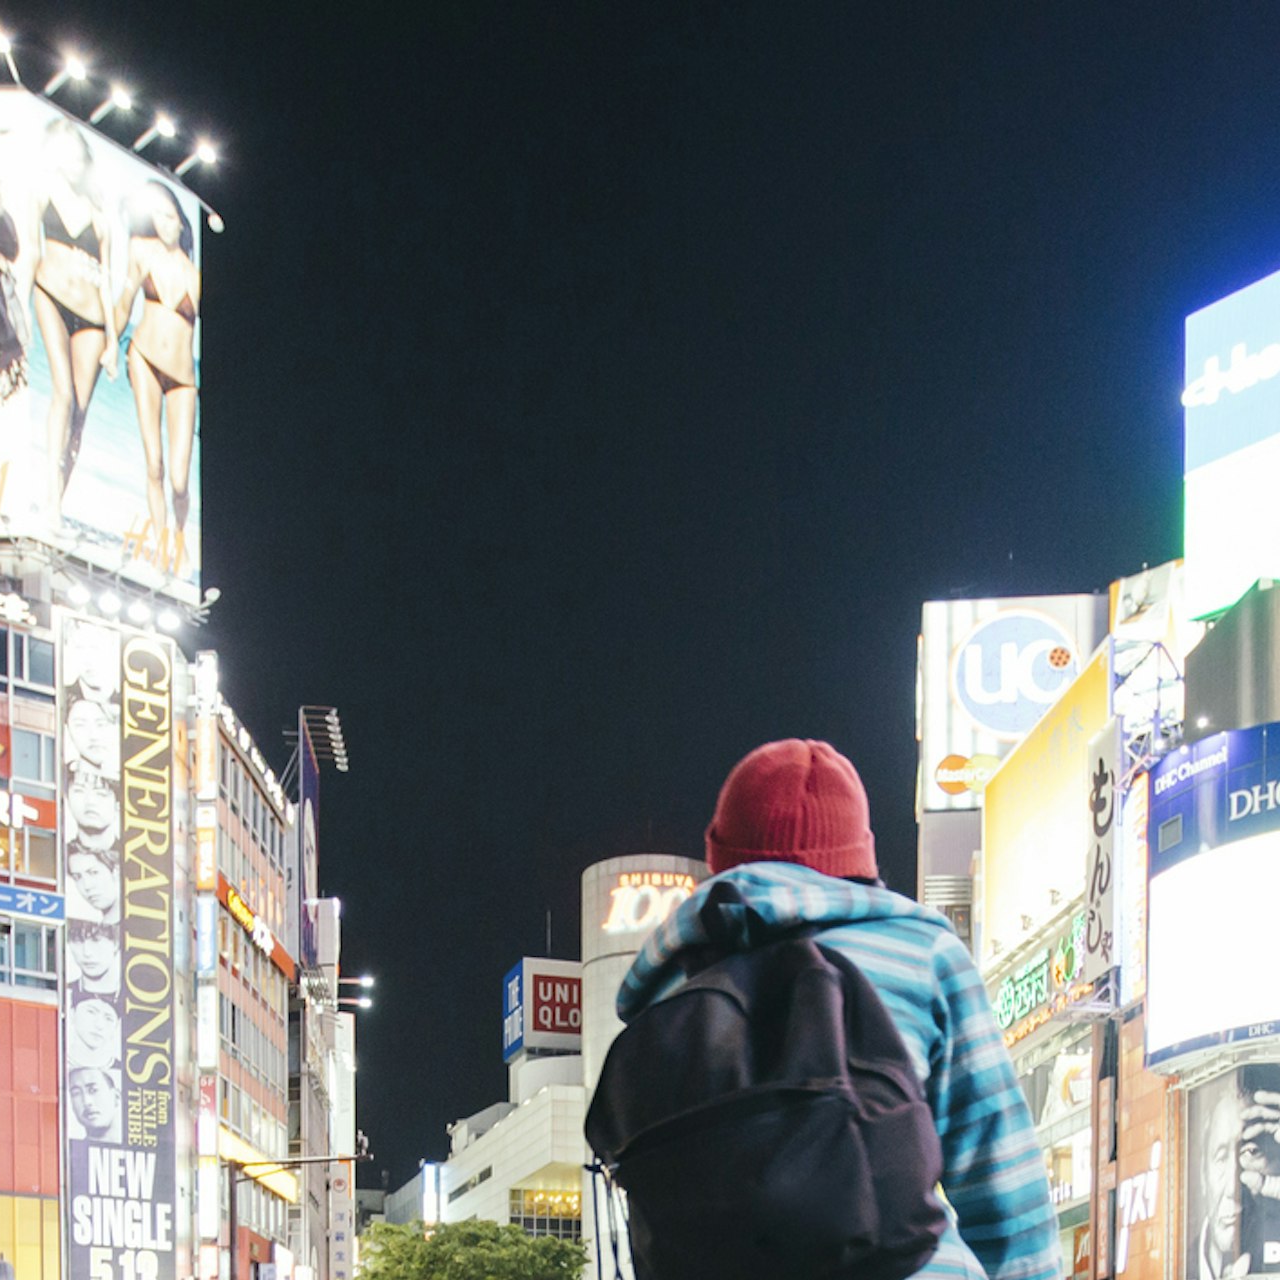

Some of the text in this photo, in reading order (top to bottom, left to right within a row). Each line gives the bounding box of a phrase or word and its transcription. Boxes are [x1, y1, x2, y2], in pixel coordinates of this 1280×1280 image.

[1154, 747, 1228, 795] DHC Channel
[123, 636, 171, 1085] GENERATIONS
[619, 872, 695, 889] SHIBUYA
[538, 981, 579, 1004] UNI
[538, 1005, 581, 1029] QLO
[1248, 1022, 1275, 1038] DHC
[126, 1087, 143, 1147] TRIBE
[141, 1089, 158, 1148] EXILE
[156, 1089, 170, 1126] from
[87, 1146, 157, 1201] NEW
[72, 1195, 172, 1251] SINGLE
